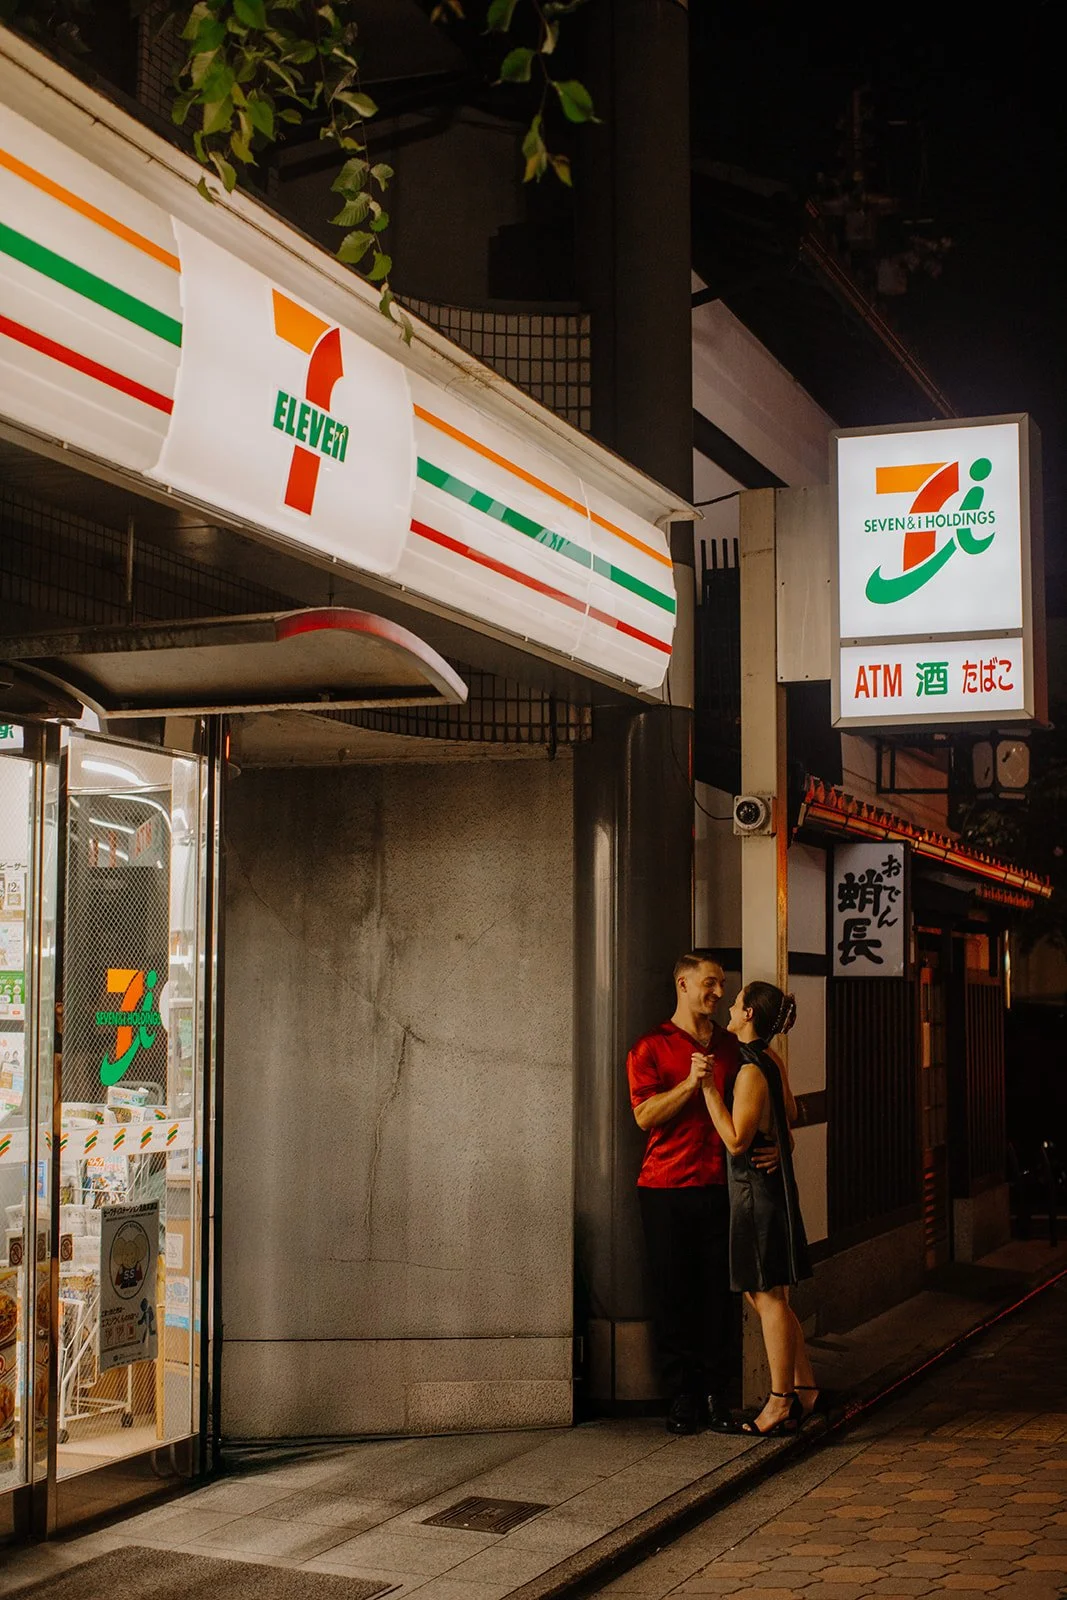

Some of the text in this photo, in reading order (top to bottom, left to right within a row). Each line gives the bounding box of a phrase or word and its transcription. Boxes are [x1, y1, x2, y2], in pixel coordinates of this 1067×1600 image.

[925, 510, 996, 529] HOLDINGS
[854, 663, 902, 699] ATM
[915, 661, 949, 698] 酒
[962, 656, 1014, 695] たばこ
[877, 854, 902, 929] おでん
